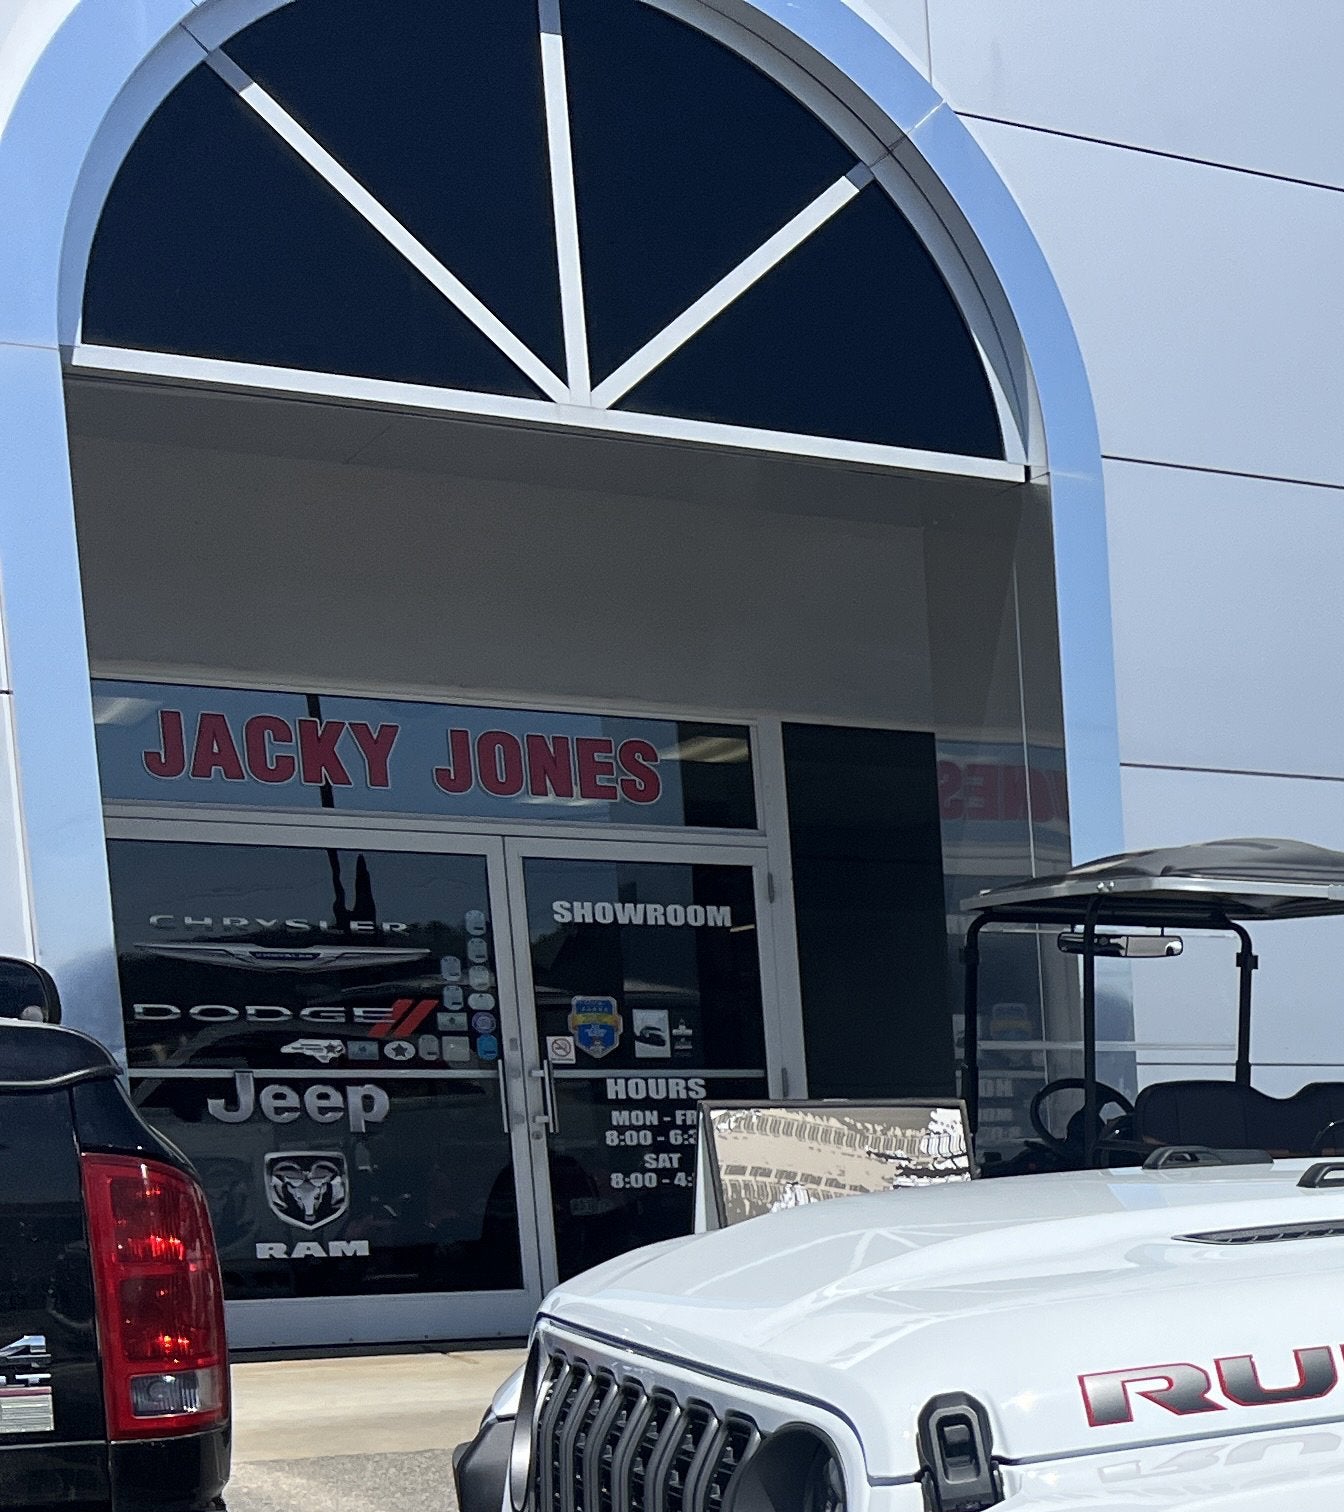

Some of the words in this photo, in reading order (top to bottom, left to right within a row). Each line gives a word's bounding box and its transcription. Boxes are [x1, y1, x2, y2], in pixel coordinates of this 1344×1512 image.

[142, 709, 400, 790] JACKY
[433, 727, 663, 805] JONES
[552, 900, 732, 927] SHOWROOM
[149, 914, 408, 935] CHRYSLER
[132, 1003, 396, 1024] DODGE
[605, 1077, 708, 1100] HOURS
[206, 1071, 390, 1133] Jeep
[611, 1110, 659, 1126] MON
[675, 1109, 697, 1126] FR
[605, 1129, 653, 1146] 8:00
[643, 1153, 682, 1169] SAT
[610, 1172, 658, 1189] 8:00
[255, 1240, 370, 1259] RAM
